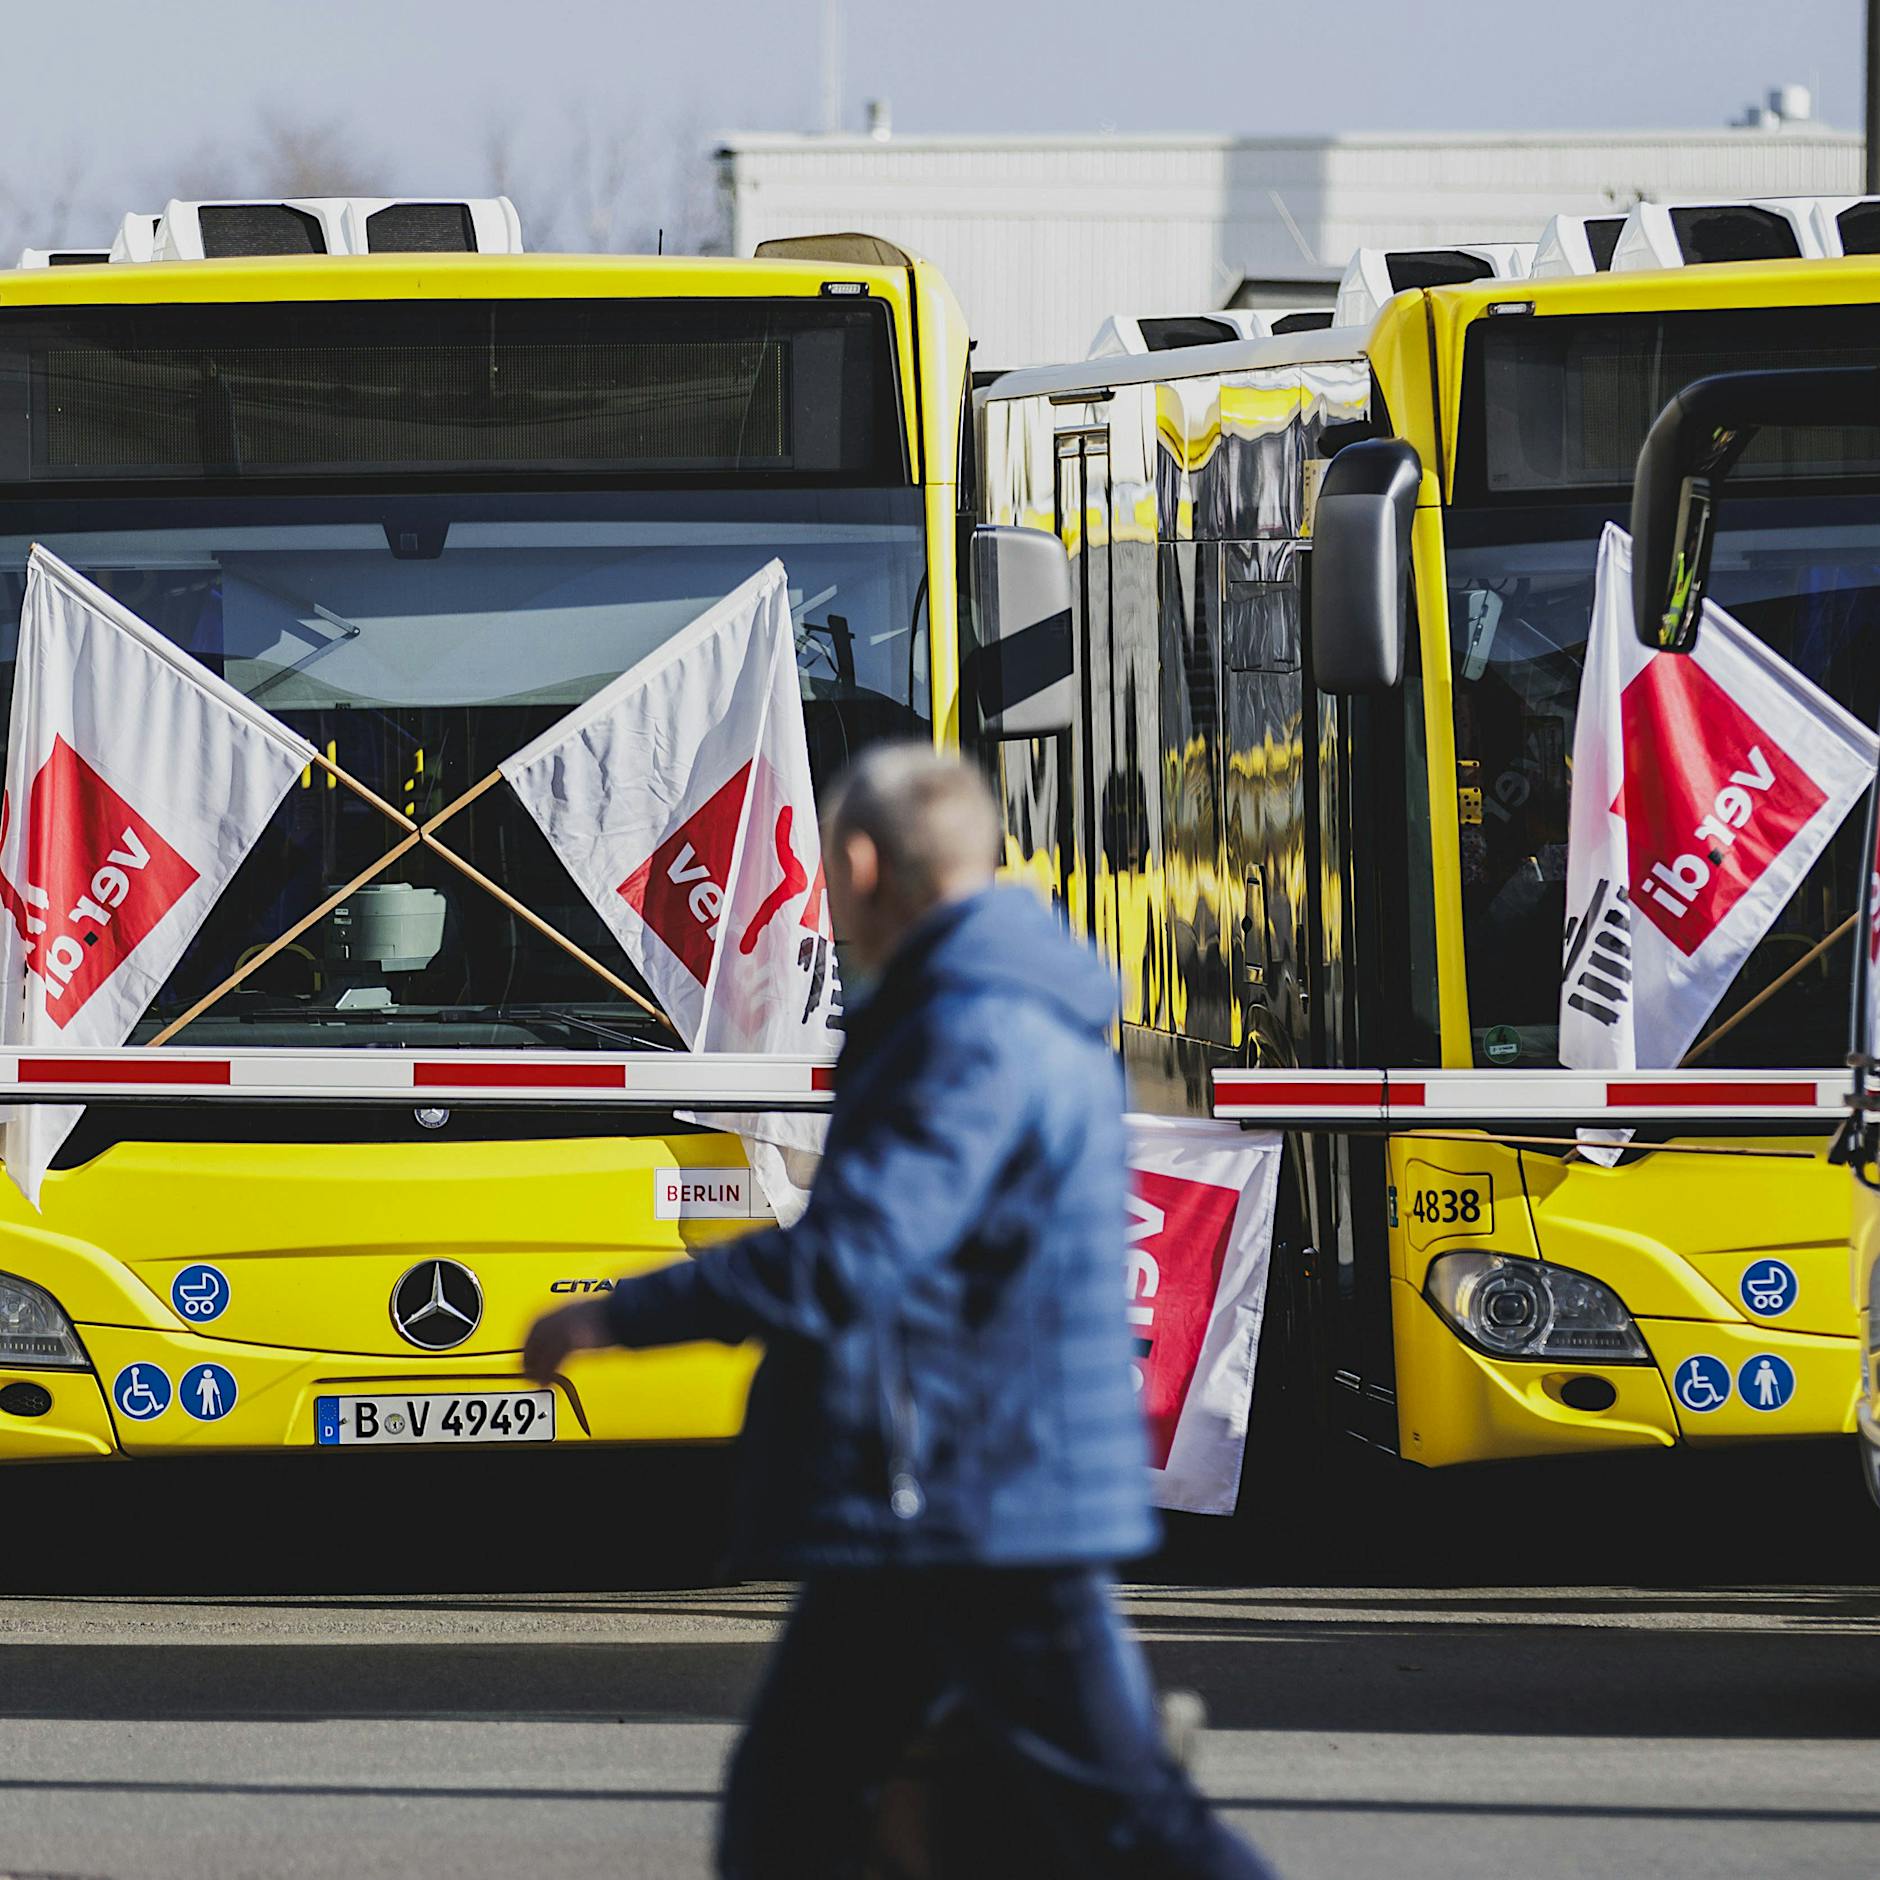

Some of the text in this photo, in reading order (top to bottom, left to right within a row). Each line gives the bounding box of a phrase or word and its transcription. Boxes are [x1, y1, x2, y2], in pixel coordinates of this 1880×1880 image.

[666, 841, 725, 941] ve
[667, 1185, 740, 1202] BERLIN
[1413, 1188, 1480, 1223] 4838
[550, 1278, 620, 1294] CITA
[356, 1398, 537, 1438] B V 4949
[324, 1426, 333, 1437] D
